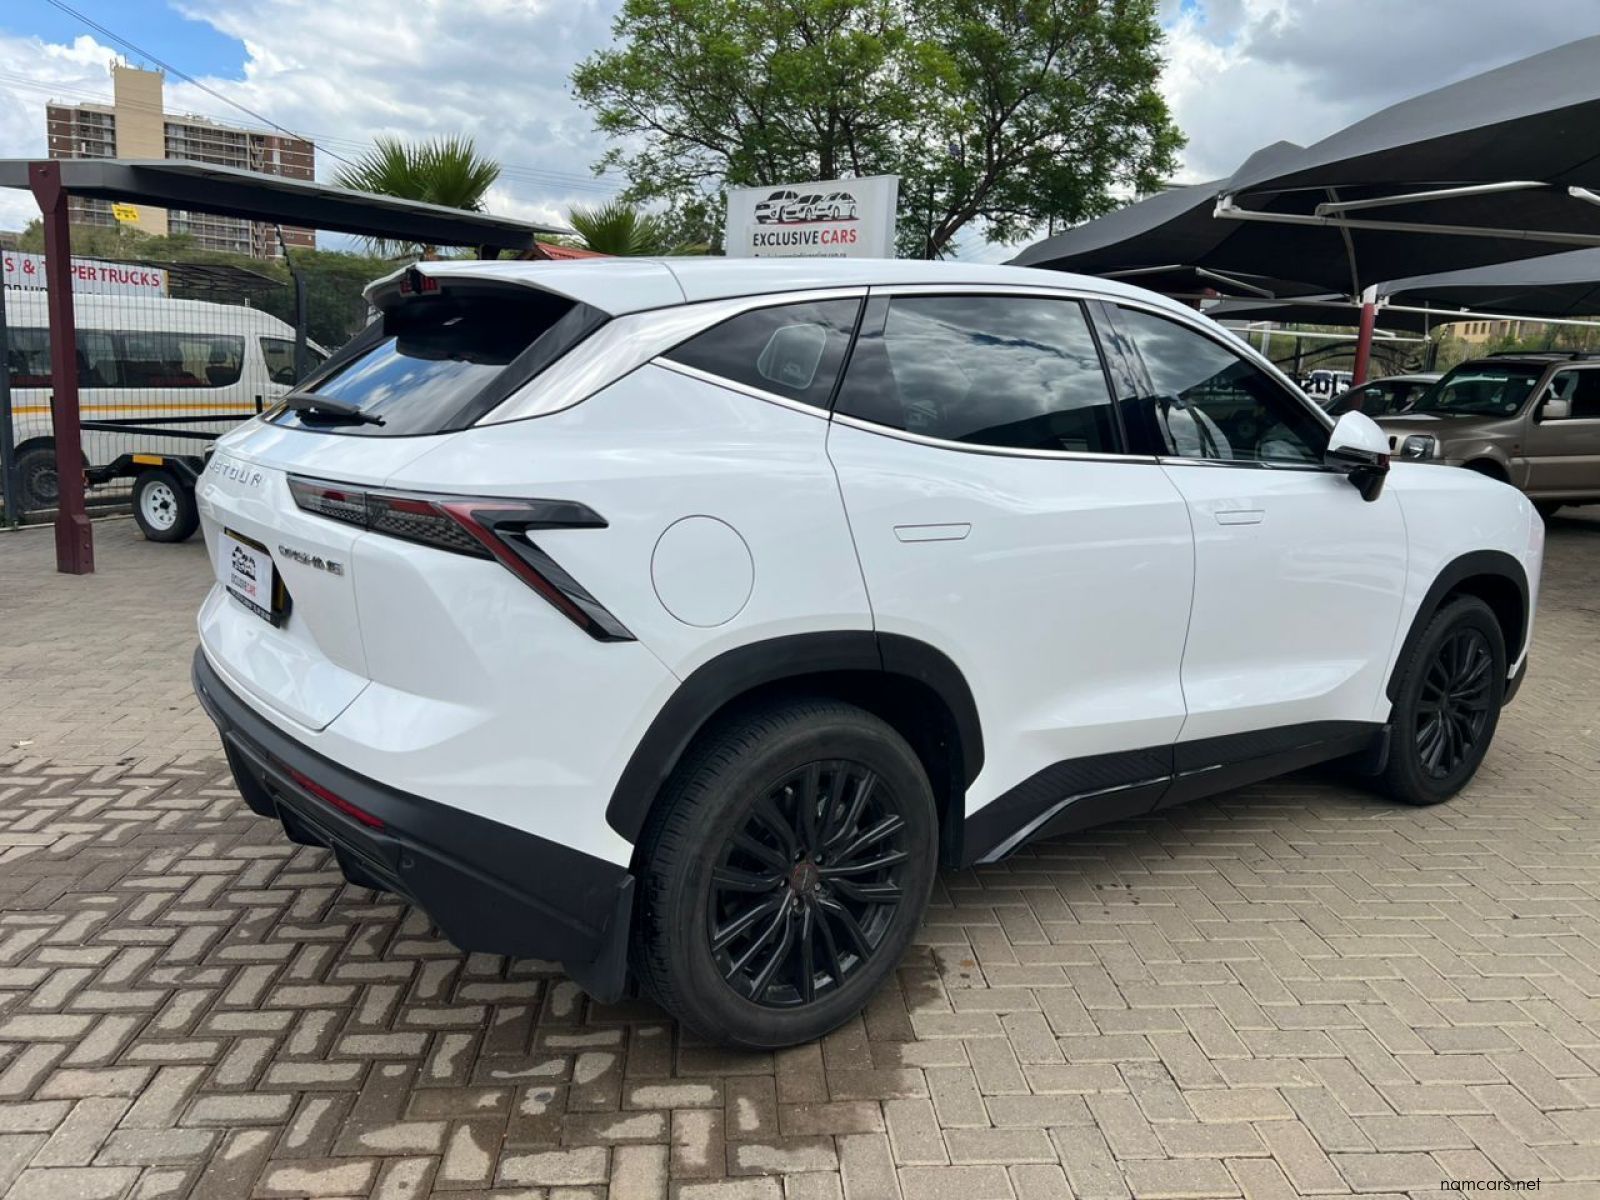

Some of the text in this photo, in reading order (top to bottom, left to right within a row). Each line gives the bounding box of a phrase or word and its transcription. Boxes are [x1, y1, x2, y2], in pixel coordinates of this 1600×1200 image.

[753, 229, 857, 247] EXCLUSIVE CARS
[23, 259, 35, 275] &
[99, 266, 160, 287] TRUCKS
[209, 460, 262, 487] JETOUR
